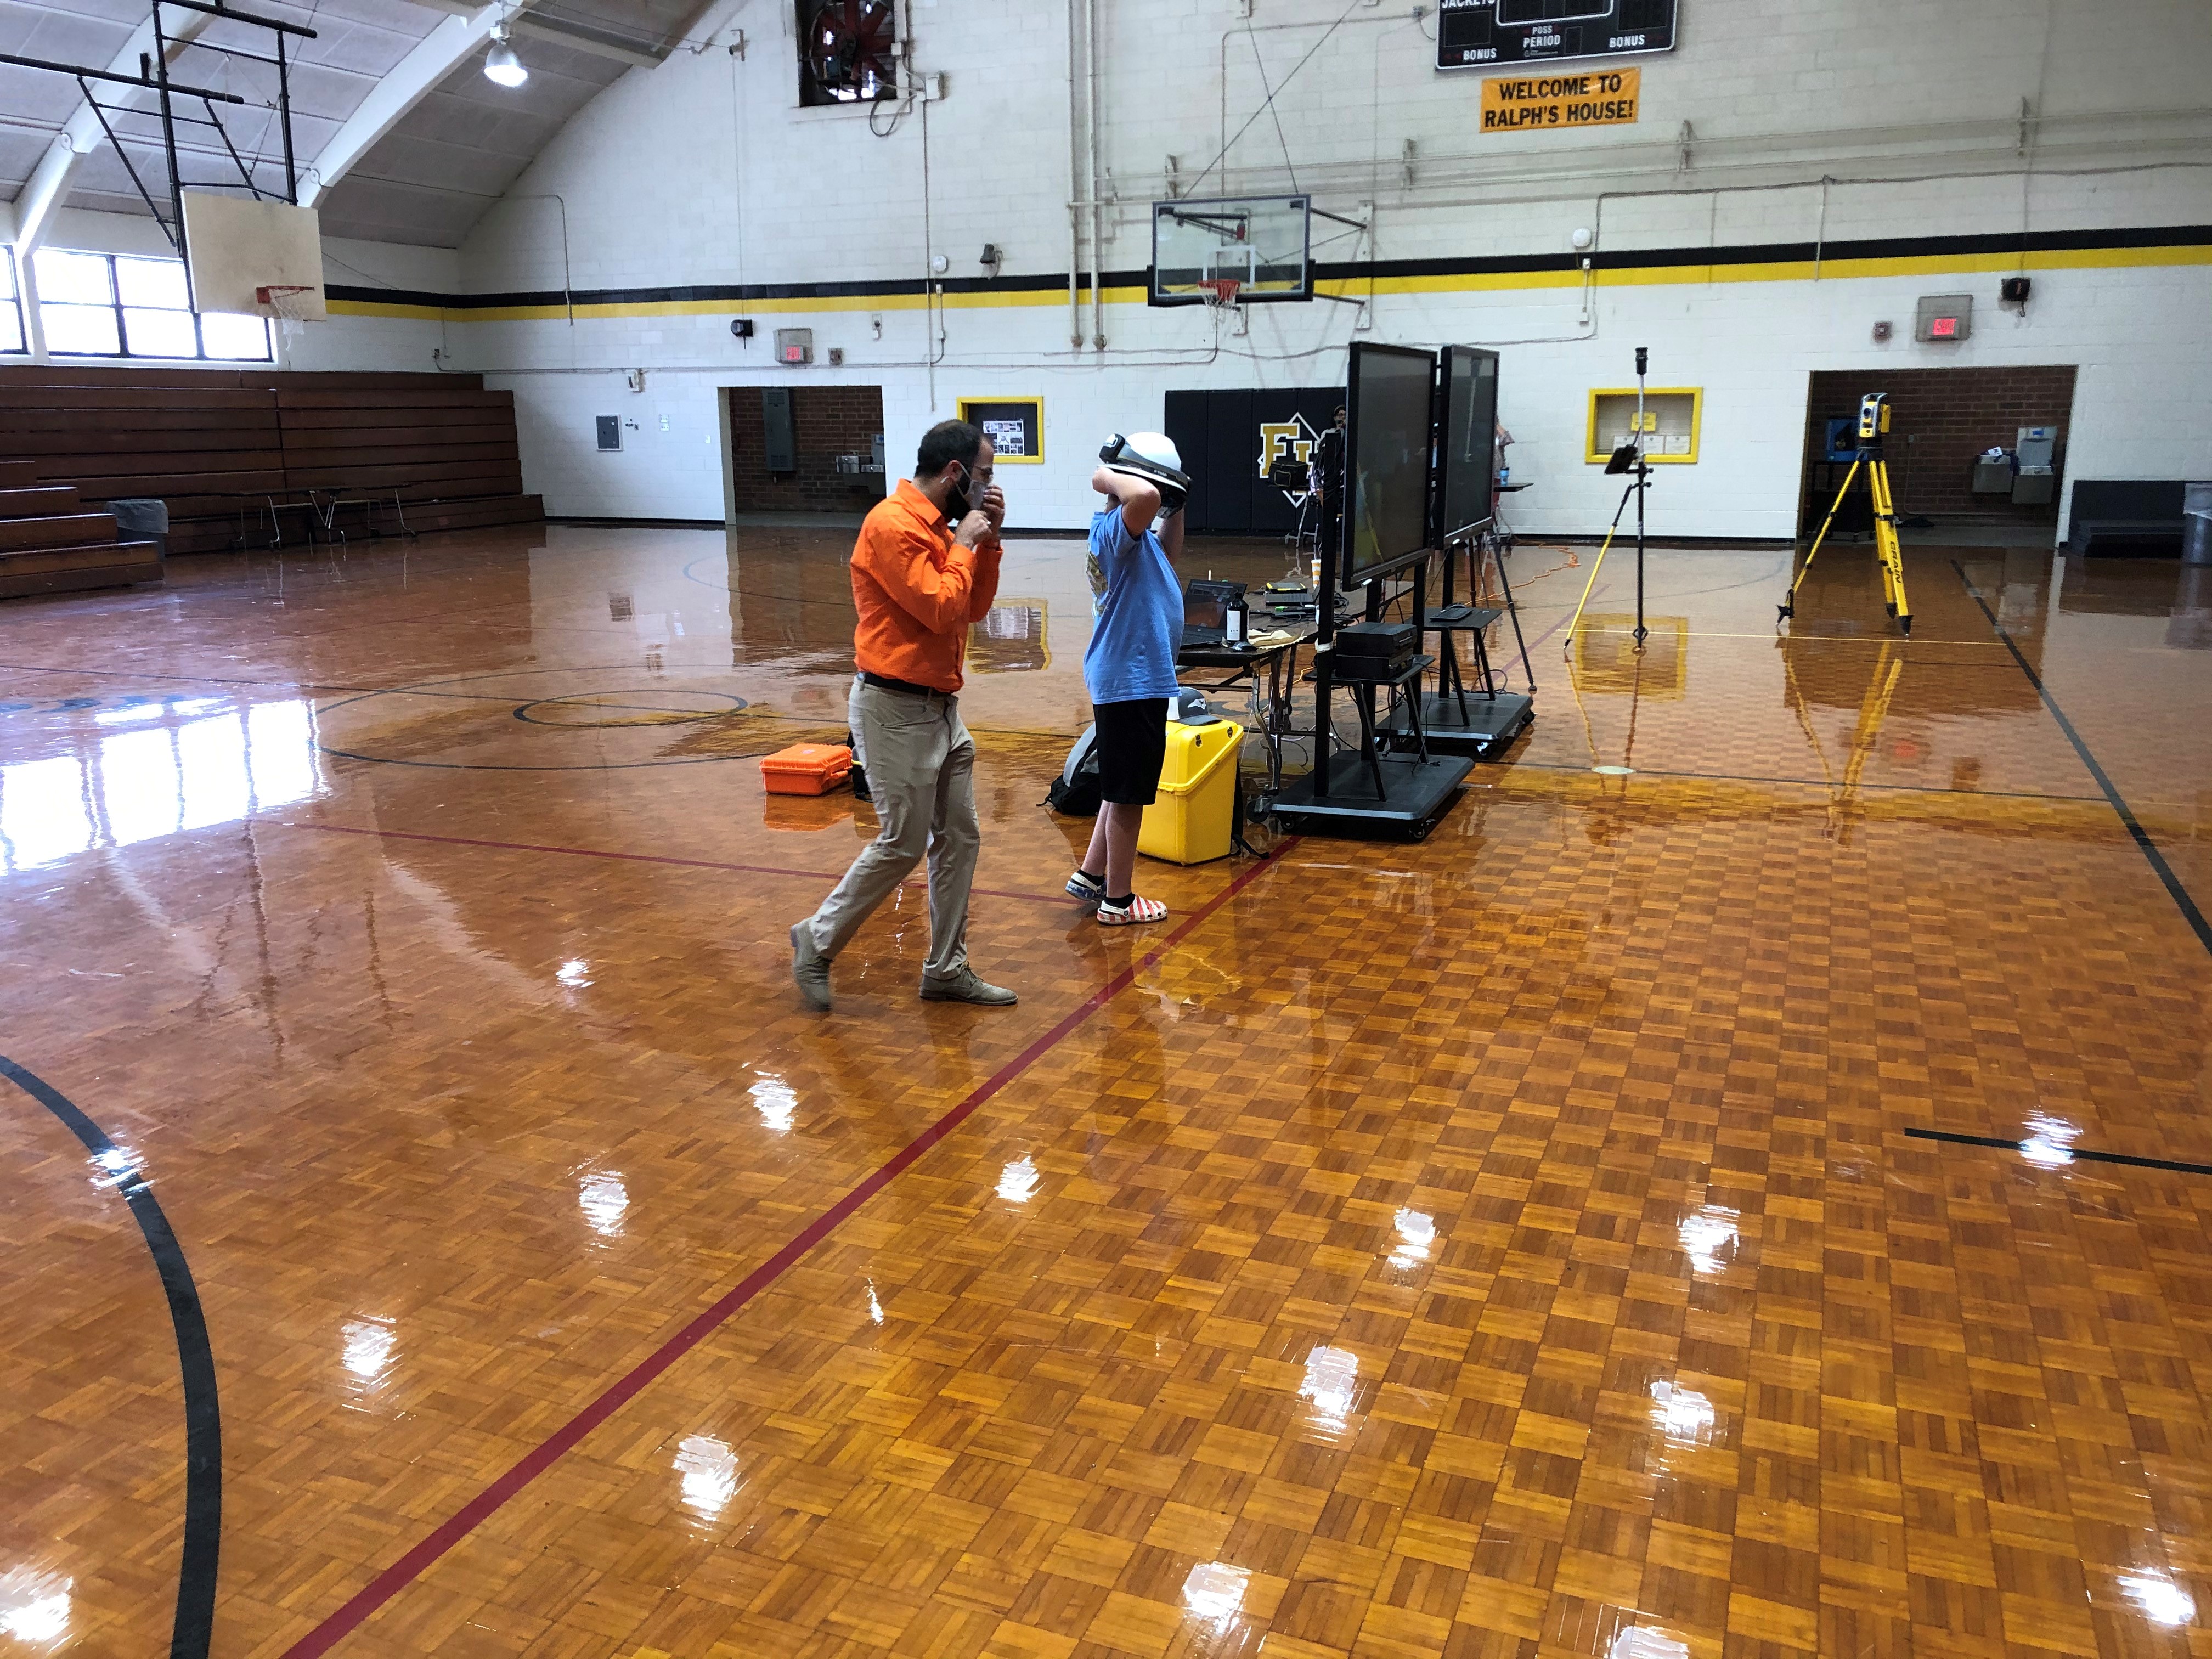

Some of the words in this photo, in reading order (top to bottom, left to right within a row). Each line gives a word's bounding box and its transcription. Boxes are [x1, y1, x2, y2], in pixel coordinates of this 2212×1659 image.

[1532, 25, 1553, 35] POSS
[1523, 35, 1561, 48] PERIOD
[1609, 35, 1645, 48] BONUS
[1463, 48, 1497, 61] BONUS
[1499, 77, 1590, 100] WELCOME
[1598, 74, 1622, 93] TO
[1485, 105, 1559, 127] RALPH'S
[1566, 99, 1633, 121] HOUSE!
